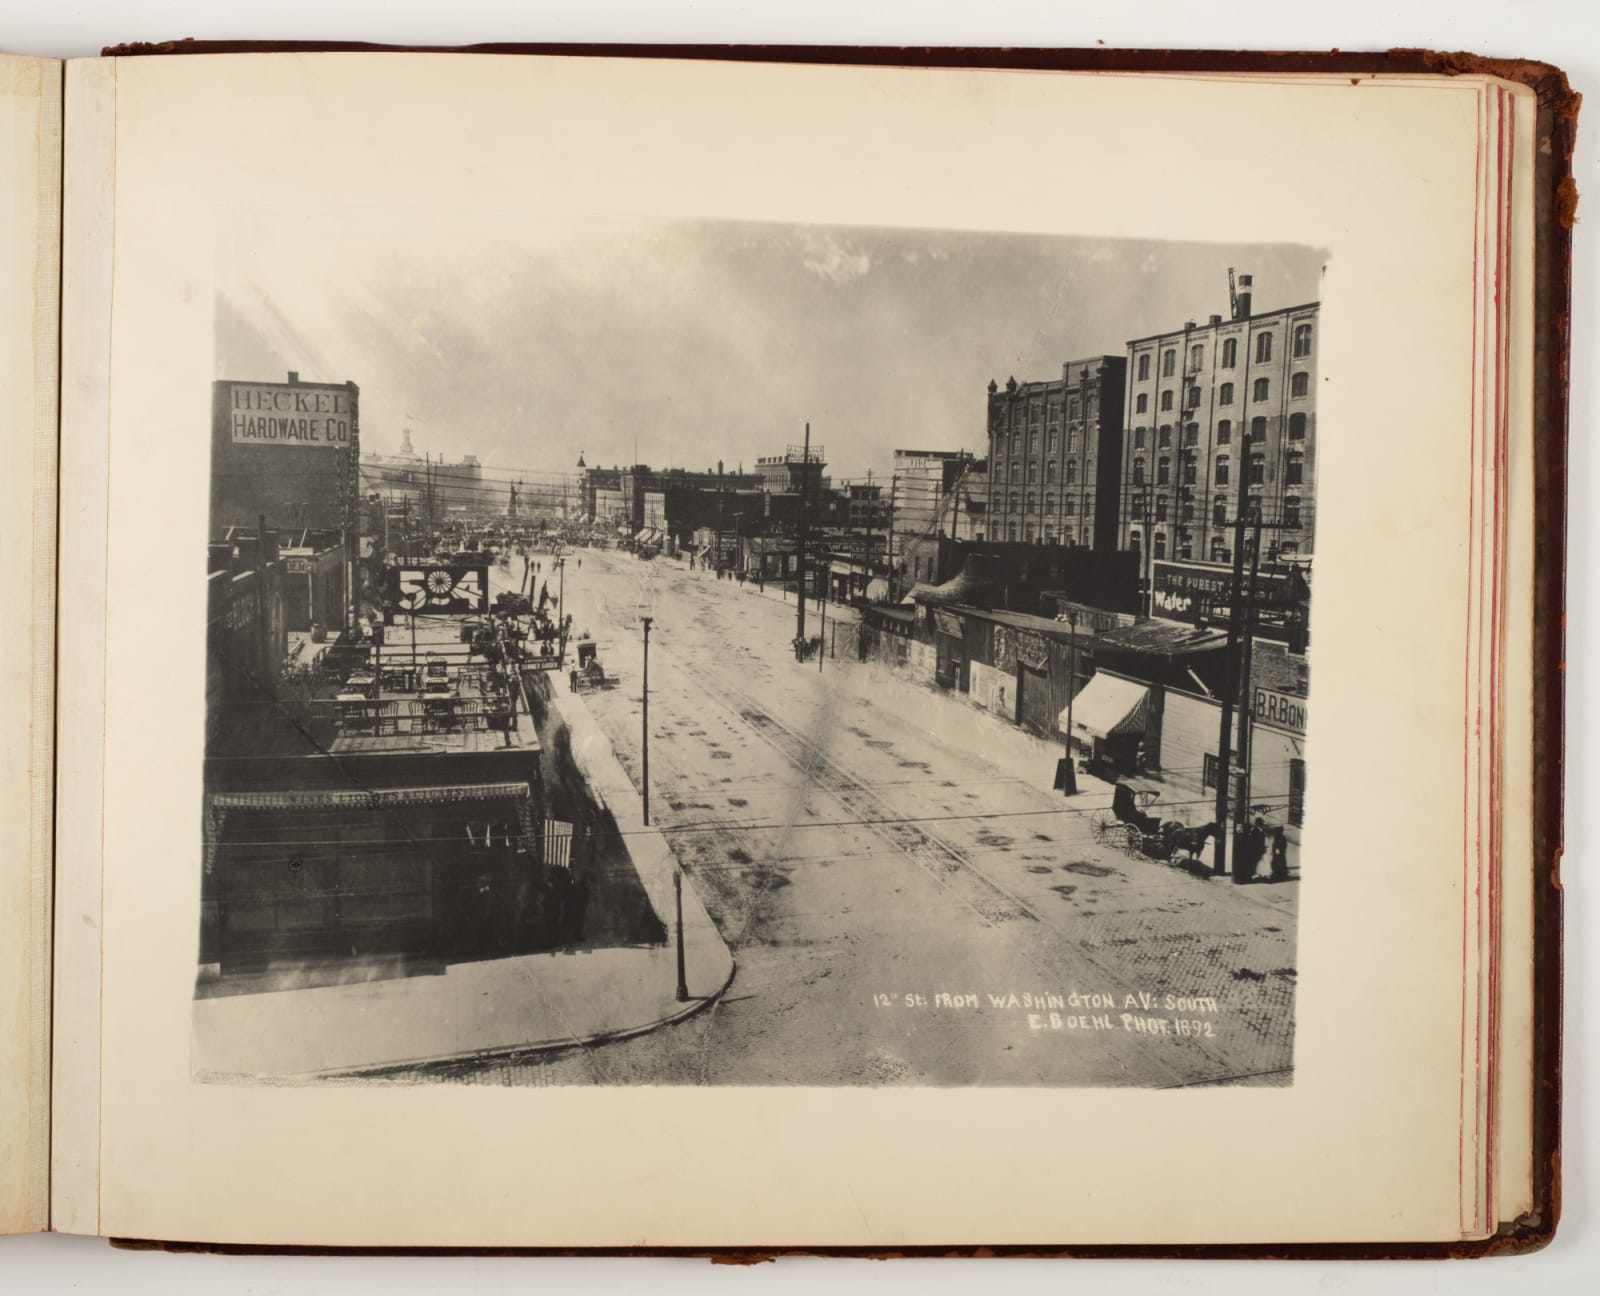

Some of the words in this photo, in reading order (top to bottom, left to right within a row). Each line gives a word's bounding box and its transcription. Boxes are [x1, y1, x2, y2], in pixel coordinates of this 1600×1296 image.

[234, 390, 348, 414] HECKEL
[233, 414, 320, 441] HARDWARE
[399, 570, 483, 610] 504
[1166, 574, 1184, 587] THE
[1186, 576, 1224, 592] PUREST
[1154, 591, 1193, 612] Water
[1257, 691, 1306, 728] B.R.BON
